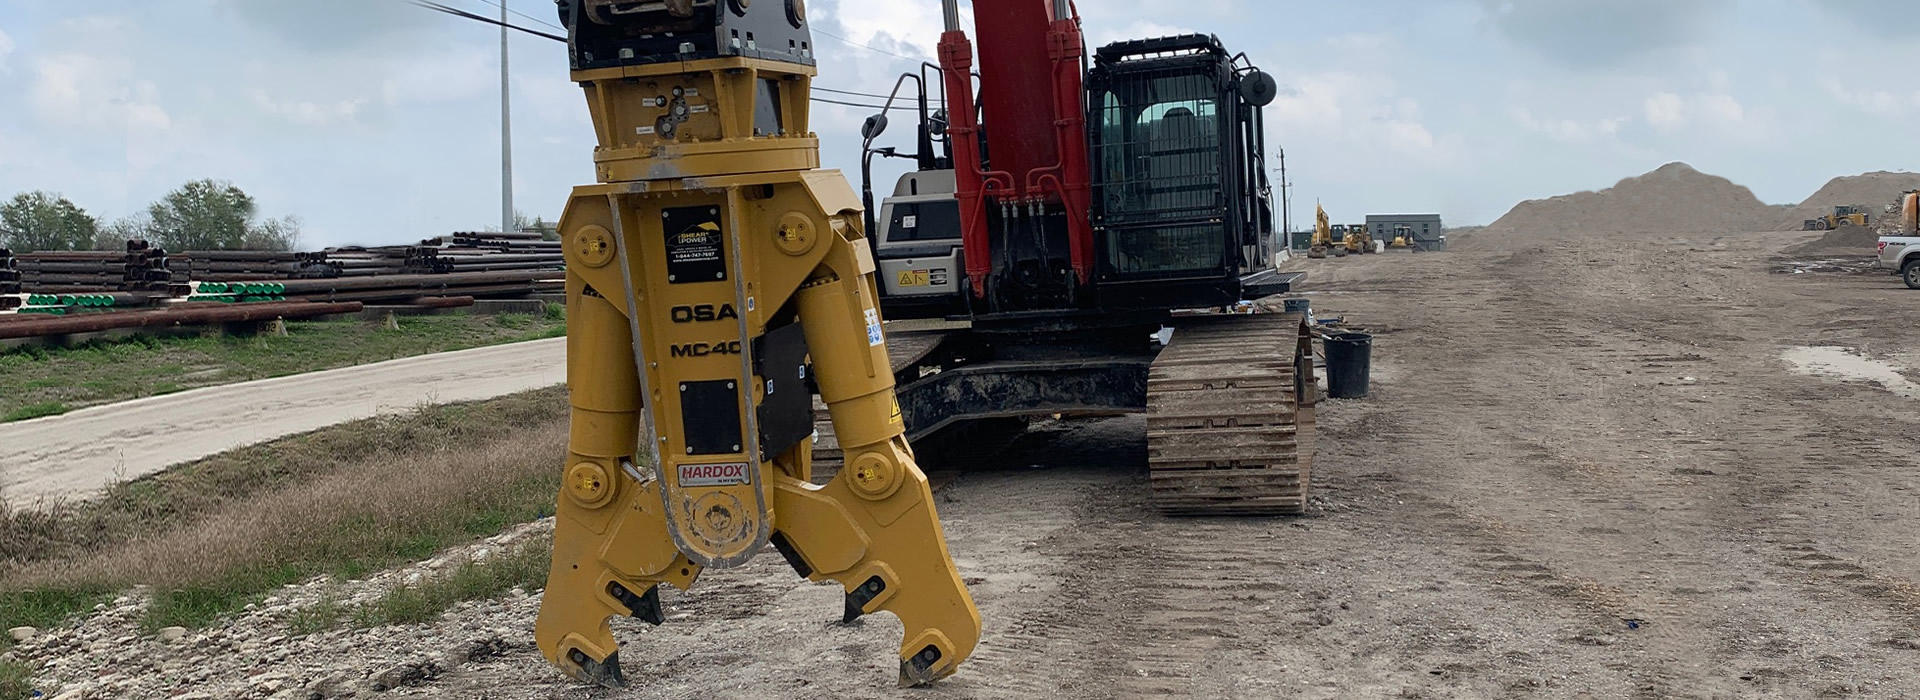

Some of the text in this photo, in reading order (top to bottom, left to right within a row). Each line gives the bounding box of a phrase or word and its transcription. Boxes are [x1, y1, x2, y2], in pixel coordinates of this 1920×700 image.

[671, 303, 738, 323] OSA
[670, 340, 741, 358] MC40
[682, 465, 743, 479] HARDOX
